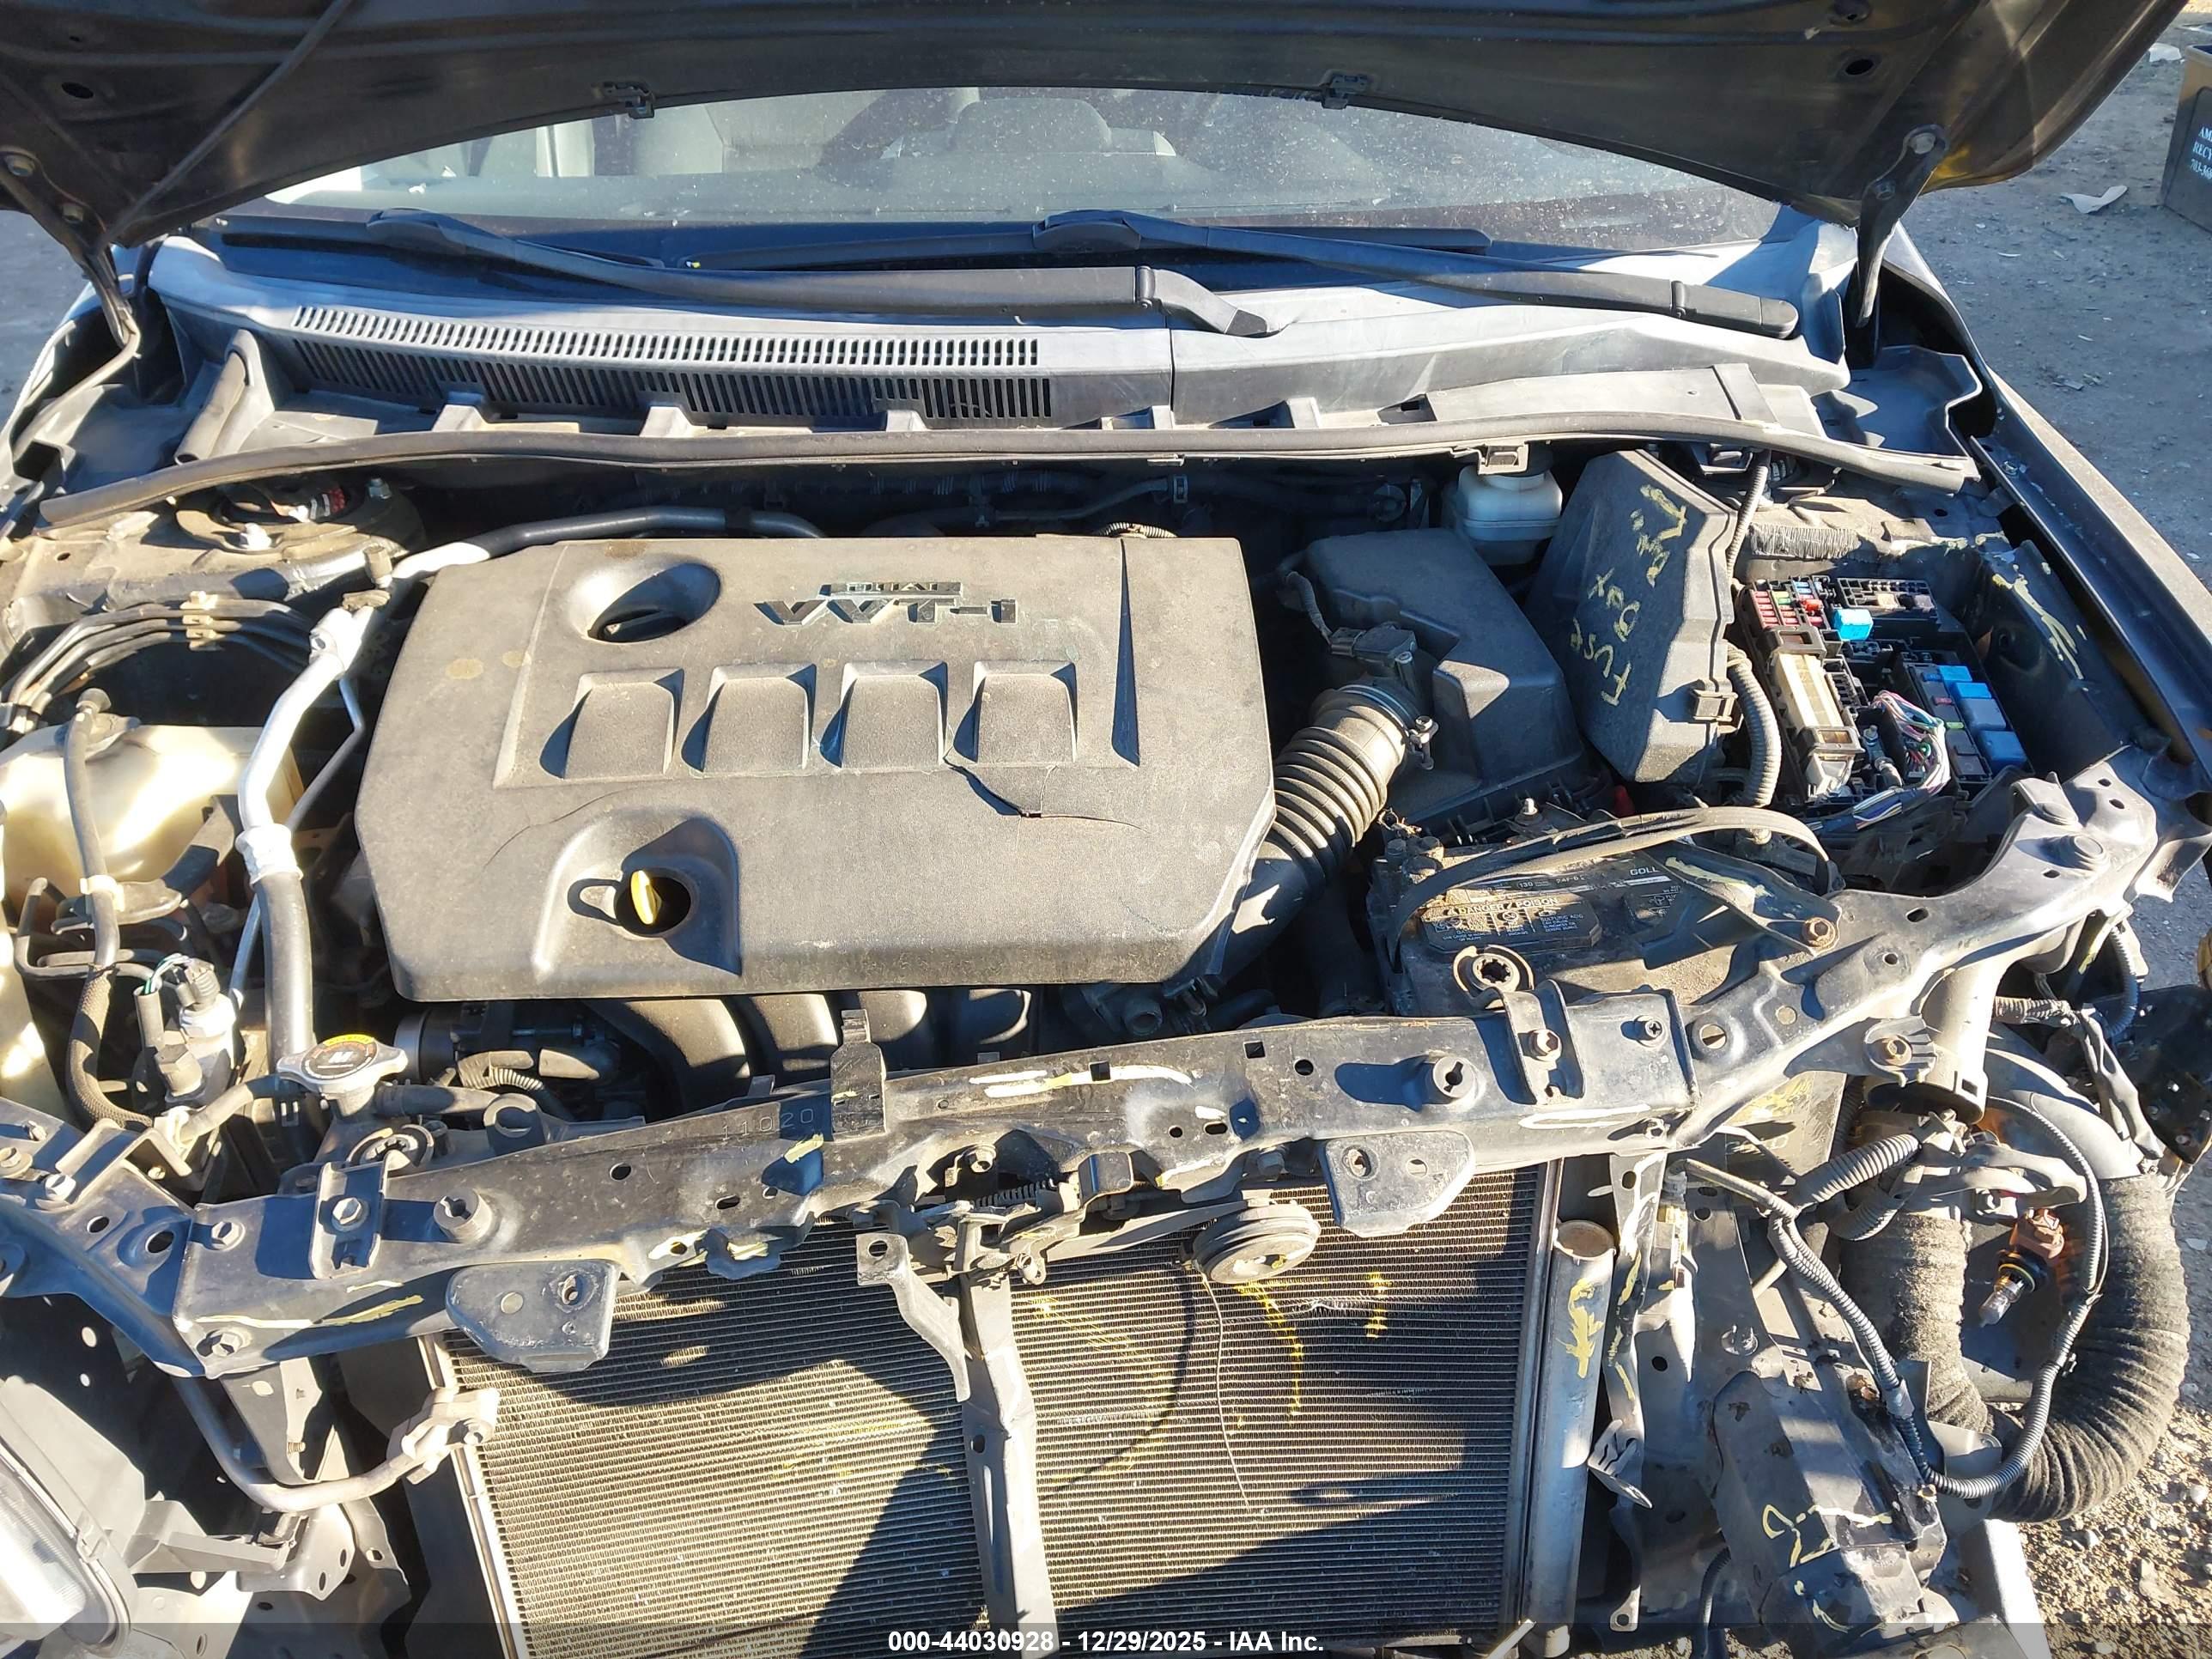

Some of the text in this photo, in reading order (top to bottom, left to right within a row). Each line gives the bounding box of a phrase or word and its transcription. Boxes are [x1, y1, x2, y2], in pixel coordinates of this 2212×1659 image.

[819, 581, 963, 599] DUAL
[1458, 903, 1504, 915] DANGER
[1516, 898, 1559, 908] POISON
